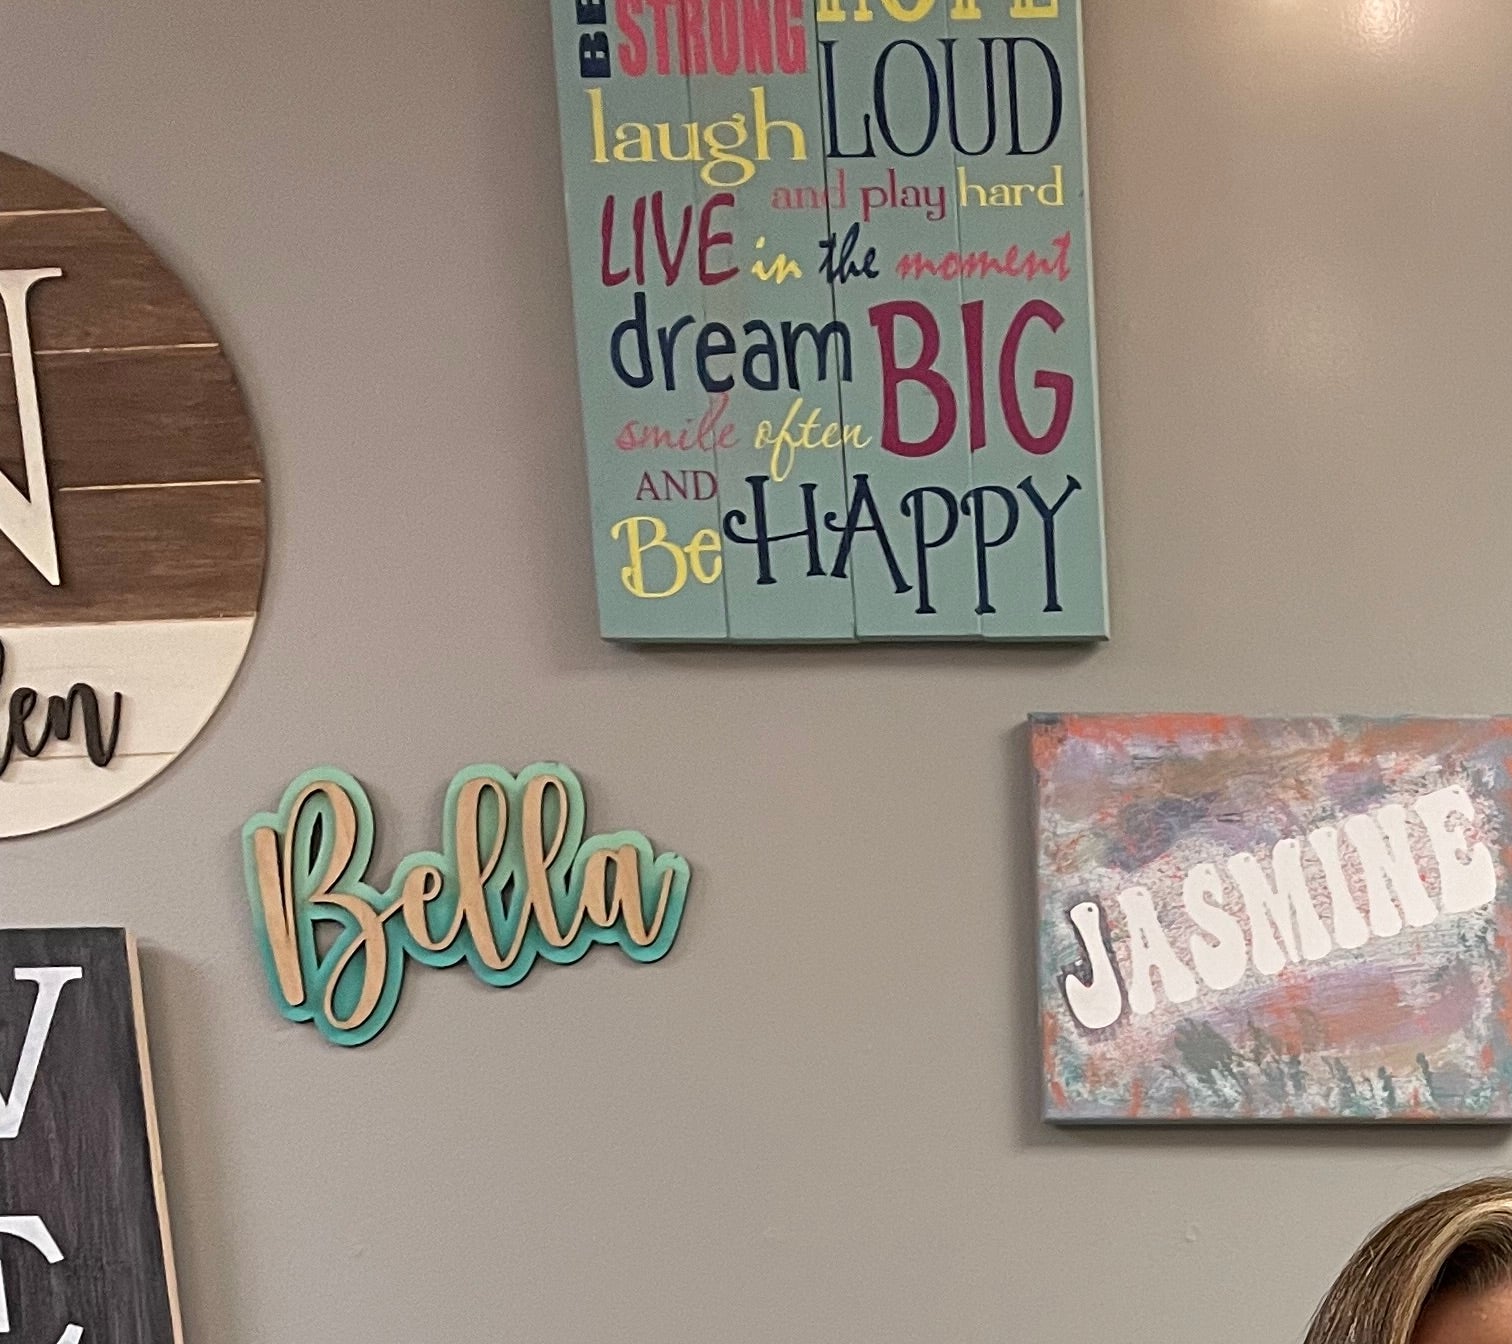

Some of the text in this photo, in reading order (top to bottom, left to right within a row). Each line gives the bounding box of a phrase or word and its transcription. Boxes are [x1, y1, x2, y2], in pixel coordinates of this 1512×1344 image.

[614, 0, 808, 77] STRONG
[586, 37, 1063, 187] laugh LOUD
[600, 190, 1072, 287] LIVE in the moment
[771, 165, 1065, 222] and play hard
[610, 291, 1075, 458] dream BIG
[615, 392, 870, 482] smile often
[636, 469, 718, 501] AND
[611, 473, 1083, 616] Be HAPPY
[253, 775, 674, 1029] Bella
[1064, 785, 1497, 1029] JASMINE
